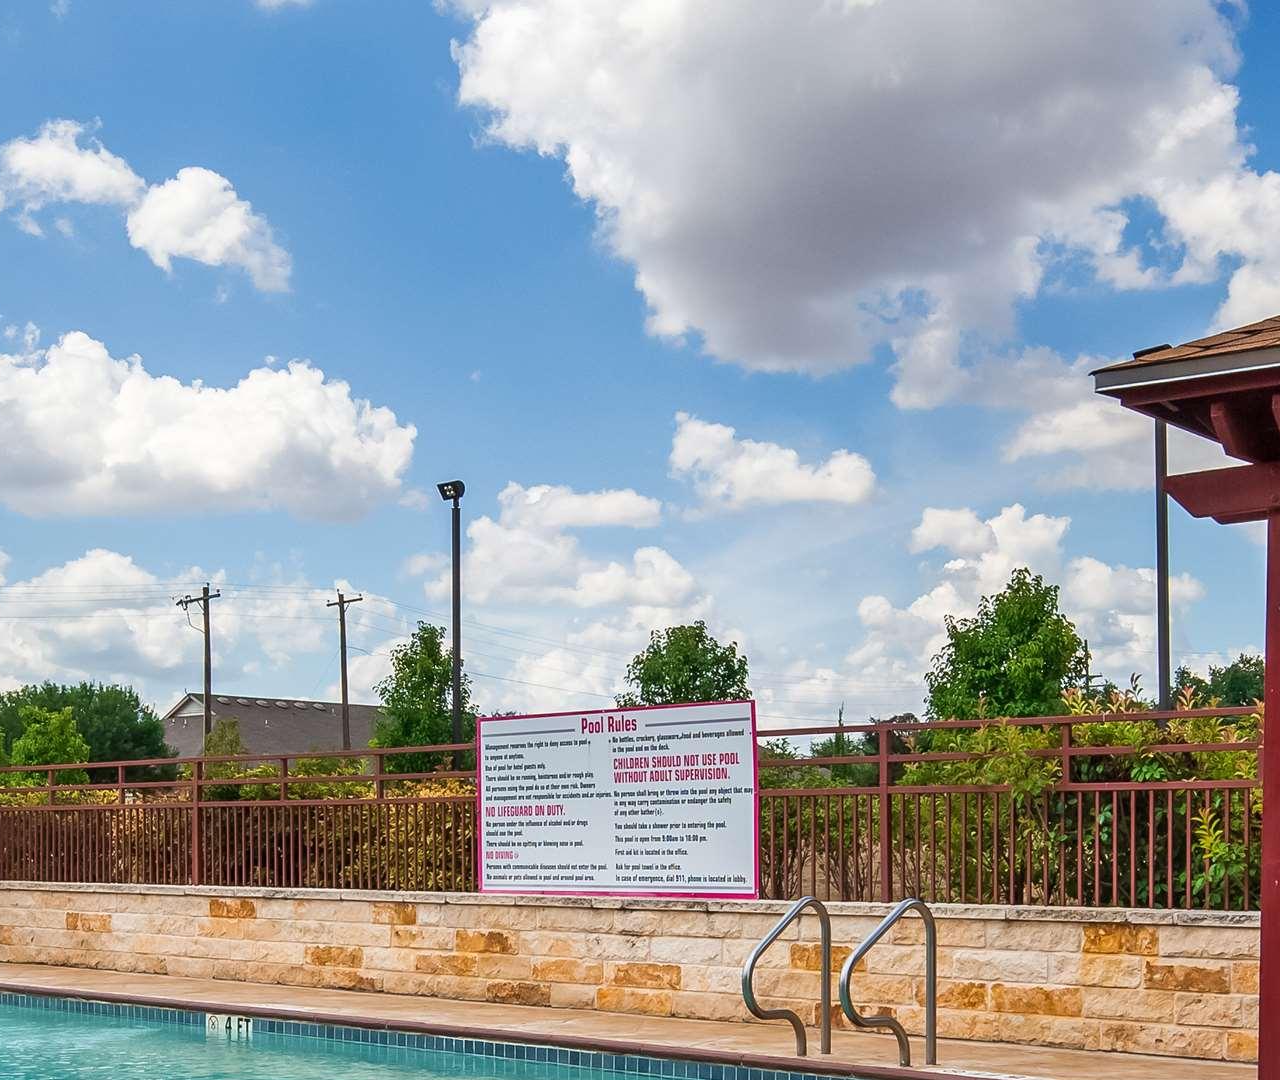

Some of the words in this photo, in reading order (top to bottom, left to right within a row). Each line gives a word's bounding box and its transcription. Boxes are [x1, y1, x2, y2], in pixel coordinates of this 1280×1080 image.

[581, 717, 604, 734] Pool
[608, 715, 637, 732] Rules
[614, 757, 649, 770] CHILDREN
[652, 755, 681, 768] SHOULD
[684, 754, 699, 766] NOT
[702, 754, 716, 766] USE
[720, 753, 740, 765] POOL
[614, 771, 647, 783] WITHOUT
[650, 770, 672, 782] ADULT
[675, 768, 730, 781] SUPERVISION.
[486, 806, 495, 817] NO
[498, 805, 532, 817] LIFEGUARD
[535, 805, 544, 816] ON
[547, 805, 565, 816] DUTY.
[486, 851, 494, 859] NO
[495, 851, 513, 859] DIVING
[225, 1017, 232, 1036] 4
[238, 1018, 251, 1039] FT
